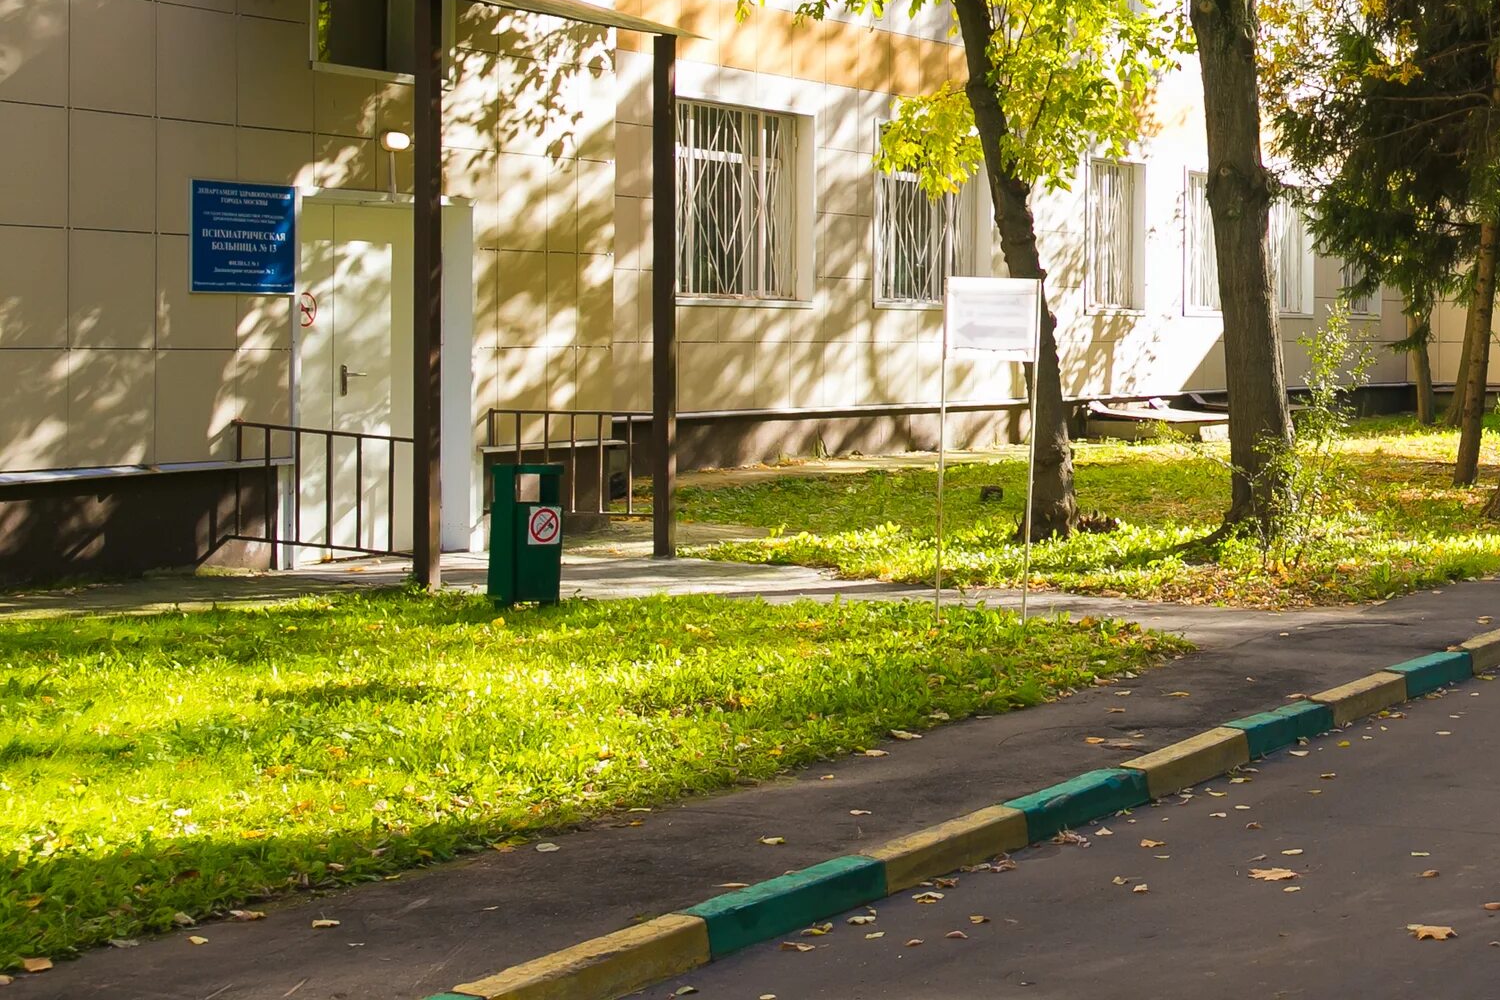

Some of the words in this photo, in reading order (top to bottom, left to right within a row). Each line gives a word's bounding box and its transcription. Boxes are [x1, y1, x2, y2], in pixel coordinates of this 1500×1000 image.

[202, 228, 286, 241] ПСИХИАТРИЧЕСКАЯ
[211, 241, 257, 252] БОЛЬНИЦА
[258, 244, 267, 252] №
[269, 244, 277, 253] 13
